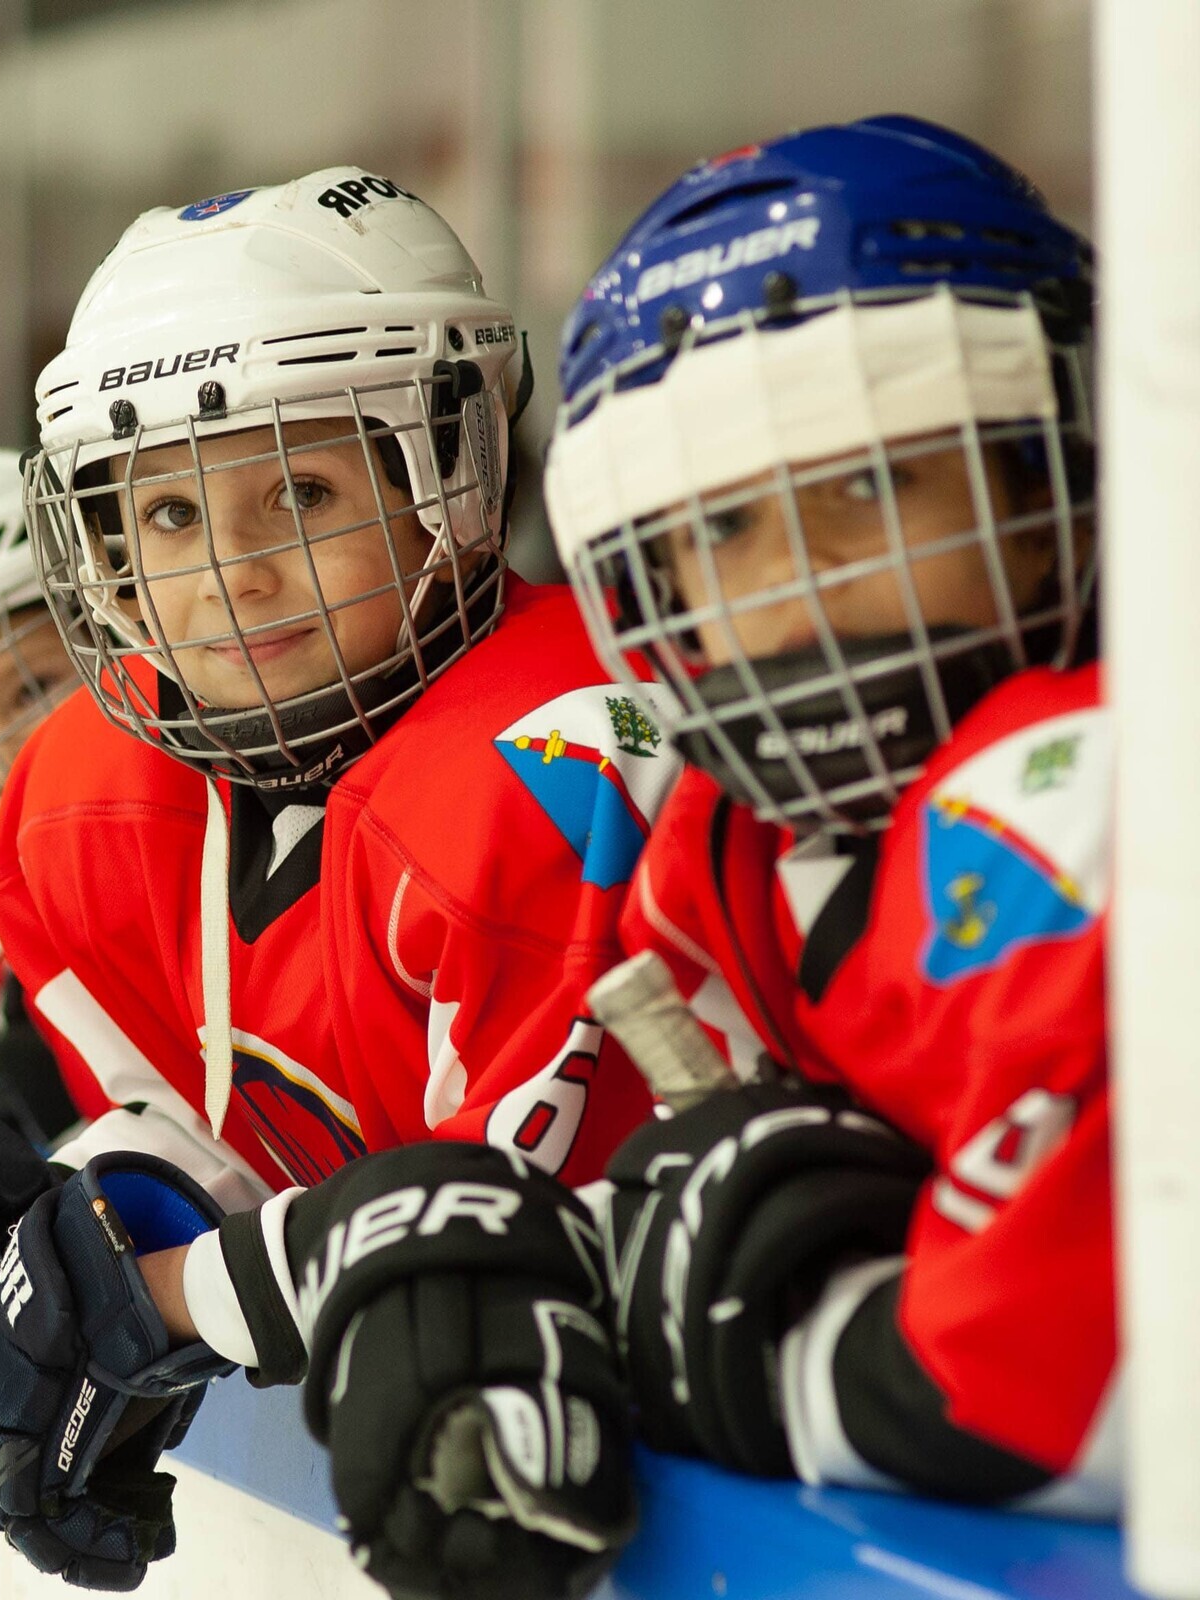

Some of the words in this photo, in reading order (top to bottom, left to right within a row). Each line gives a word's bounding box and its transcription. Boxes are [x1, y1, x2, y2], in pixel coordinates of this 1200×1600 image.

[634, 216, 821, 301] BAUER
[98, 342, 241, 392] BAUER
[255, 742, 345, 790] AUER
[300, 1181, 523, 1336] UER
[57, 1377, 97, 1472] QREDGE
